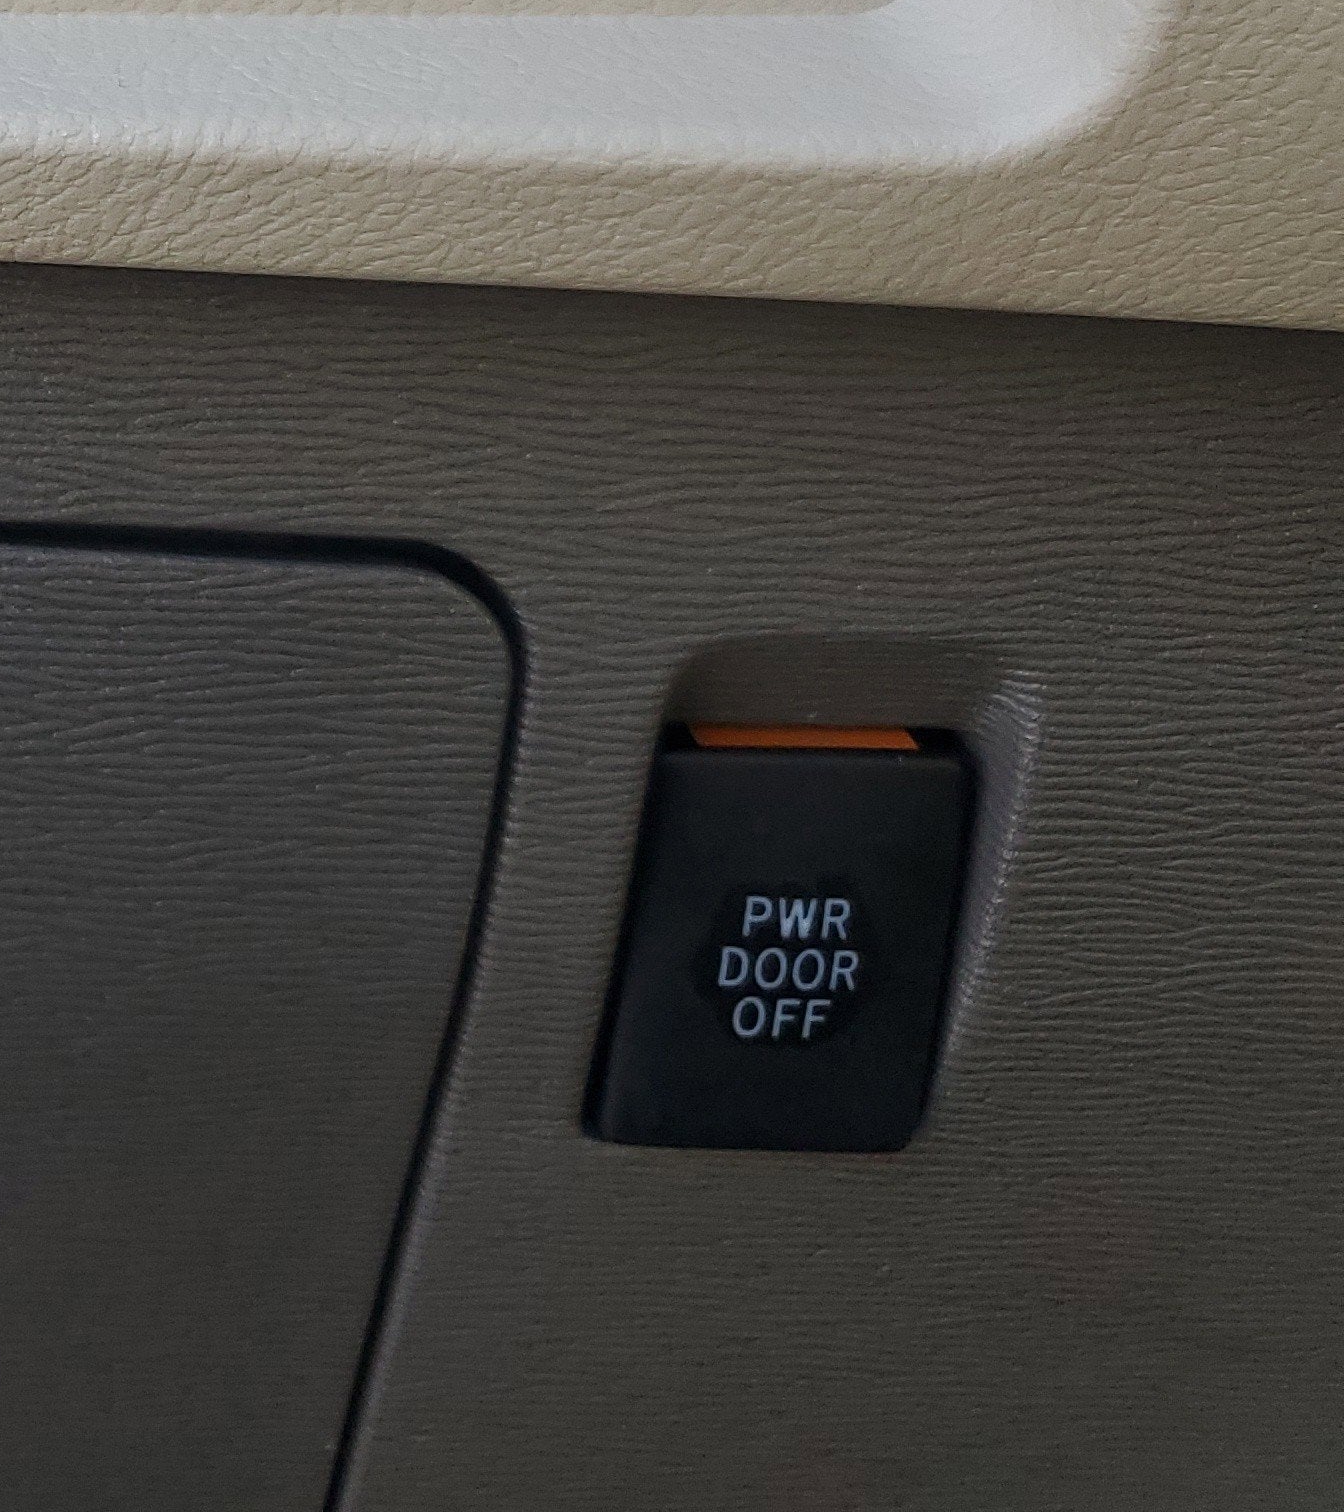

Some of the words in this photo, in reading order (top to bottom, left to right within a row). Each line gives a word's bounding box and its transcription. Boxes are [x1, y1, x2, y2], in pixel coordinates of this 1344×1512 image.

[741, 894, 852, 941] PWR
[716, 944, 860, 993] DOOR
[730, 995, 833, 1041] OFF
